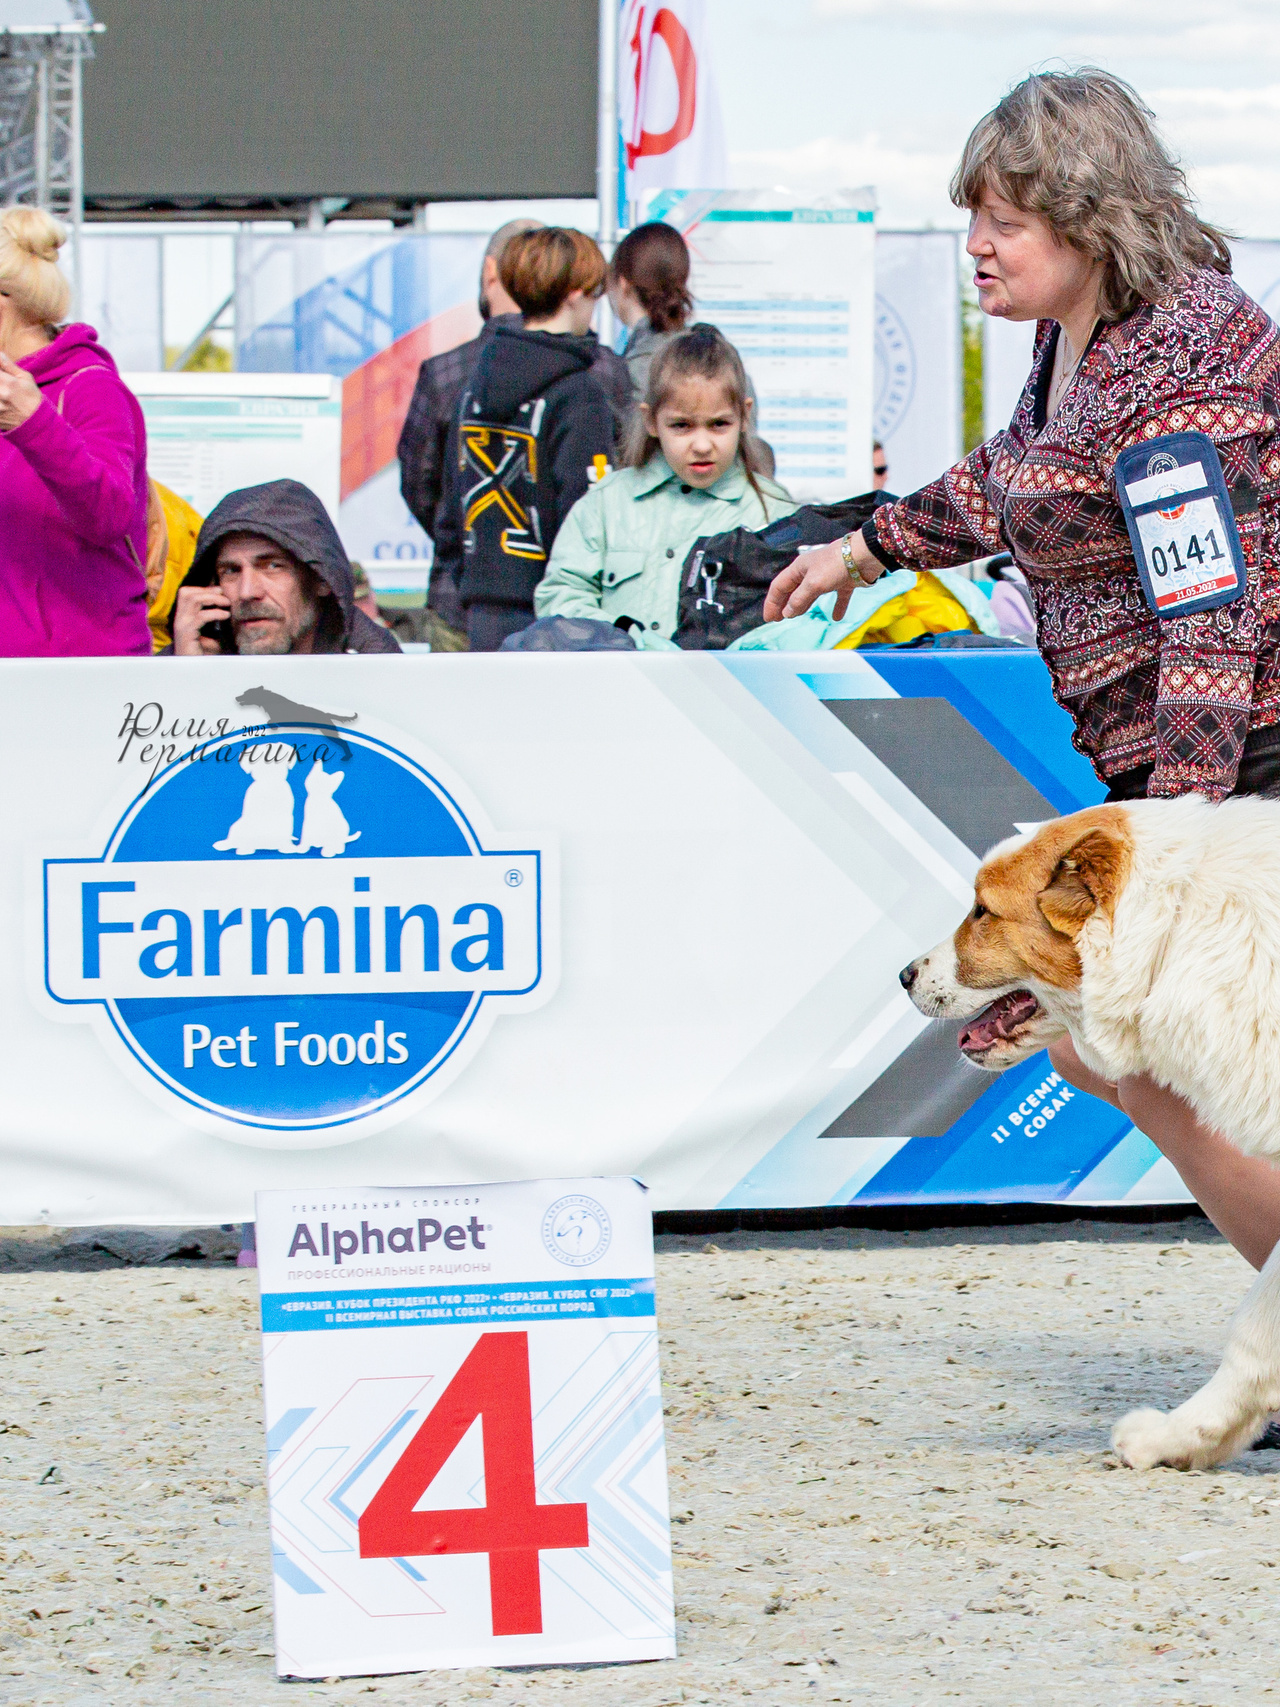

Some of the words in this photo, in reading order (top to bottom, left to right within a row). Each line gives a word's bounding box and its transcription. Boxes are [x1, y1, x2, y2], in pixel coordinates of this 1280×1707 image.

[1151, 528, 1226, 577] 0141
[1175, 580, 1218, 600] 21.05.2022
[82, 876, 505, 980] Farmina
[182, 1023, 257, 1068] Pet
[274, 1019, 410, 1067] Foods
[1008, 1071, 1063, 1126] ВСЕМИ
[1023, 1086, 1076, 1138] СОБАК
[291, 1200, 402, 1213] ГЕНЕРАЛЬНЫЙ
[412, 1197, 482, 1208] СПОНСОР
[287, 1214, 487, 1265] AlphaPet
[287, 1264, 426, 1281] ПРОФЕССИОНАЛЬНЫЕ
[429, 1262, 491, 1276] РАЦИОНЫ
[335, 1311, 397, 1322] ВСЕМИРНАЯ
[398, 1308, 453, 1320] ВЫСТАВКА
[455, 1306, 488, 1317] СОБАК
[490, 1303, 558, 1315] РОССИЙСКИХ
[559, 1302, 596, 1312] ПОРОД
[336, 1299, 371, 1310] КУБОК
[372, 1296, 438, 1307] ПРЕЗИДЕНТА
[439, 1294, 462, 1305] РКФ
[553, 1289, 587, 1300] КУБОК
[589, 1288, 609, 1298] СНГ
[357, 1330, 590, 1638] 4
